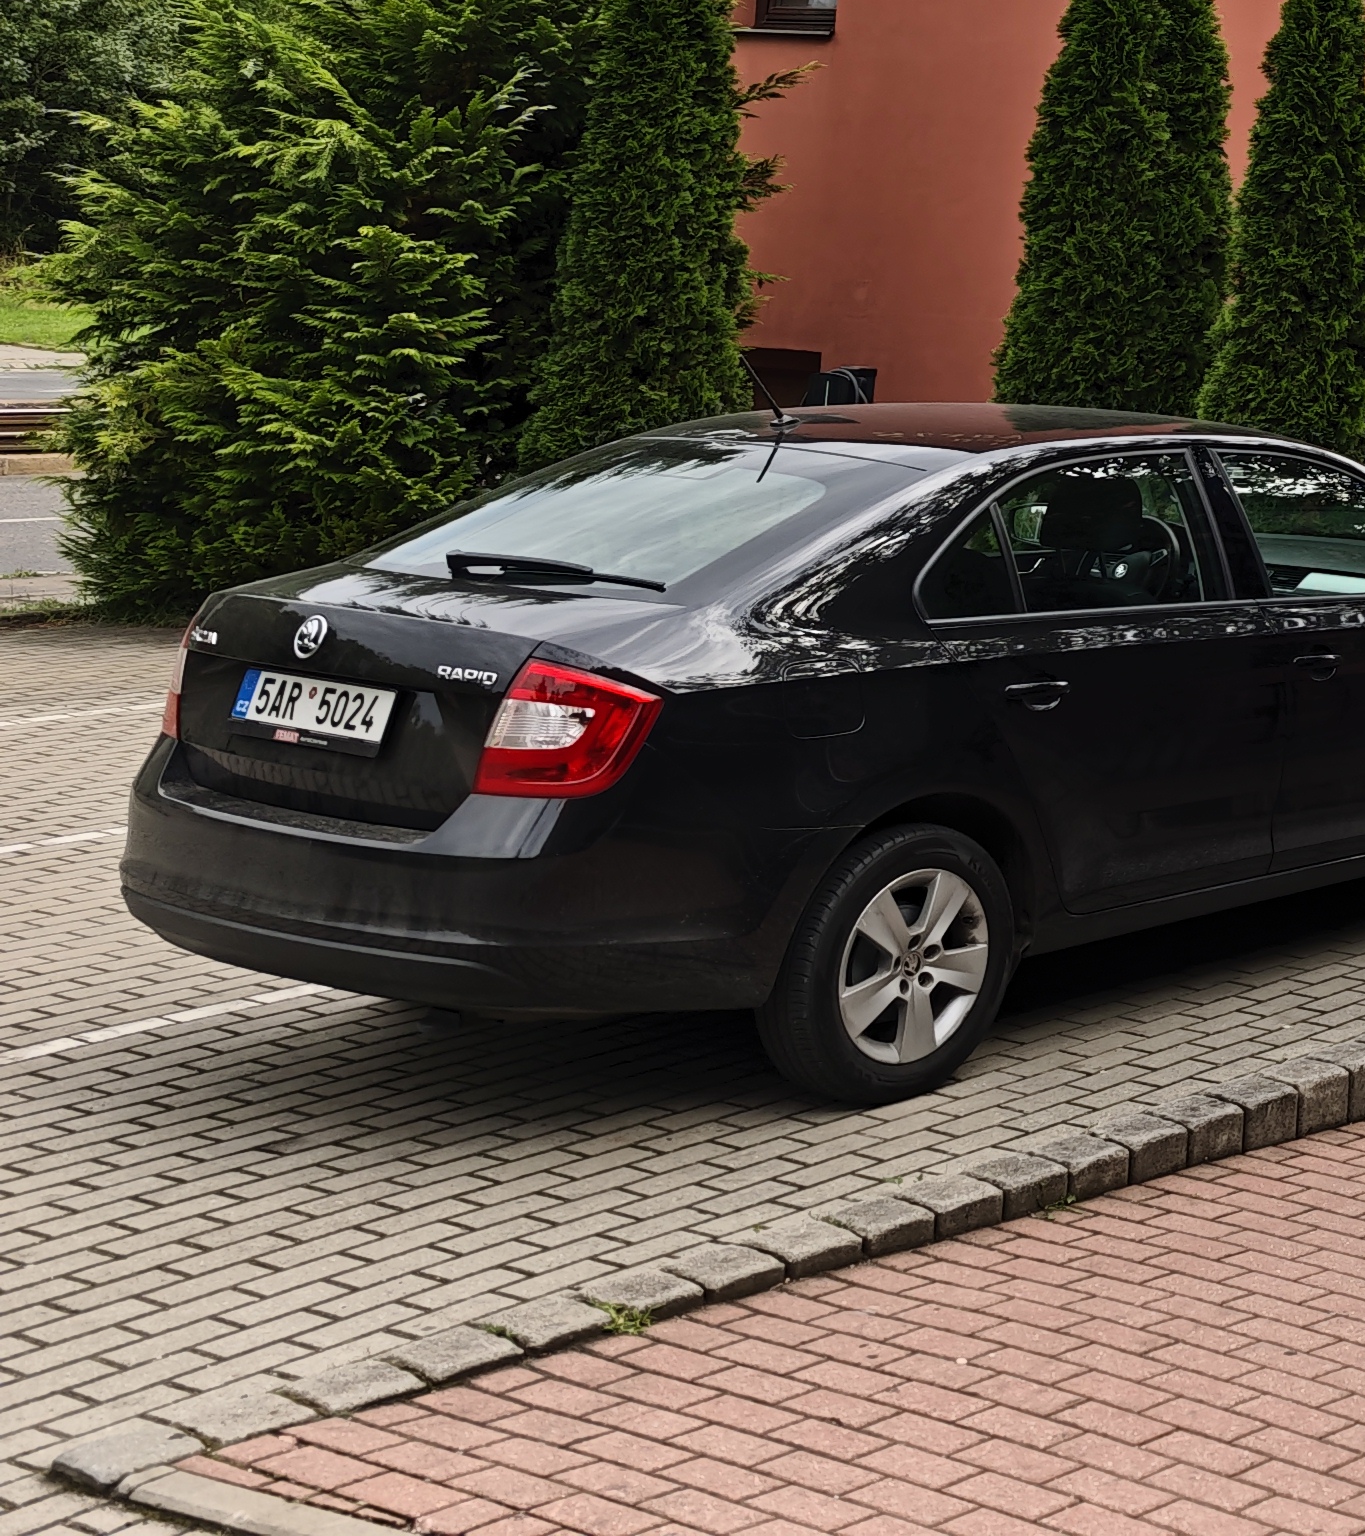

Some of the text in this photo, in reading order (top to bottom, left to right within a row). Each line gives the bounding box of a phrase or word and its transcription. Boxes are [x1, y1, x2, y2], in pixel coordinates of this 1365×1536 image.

[437, 665, 498, 686] RAPID
[236, 699, 250, 713] CZ
[255, 677, 380, 734] 5AR 5024
